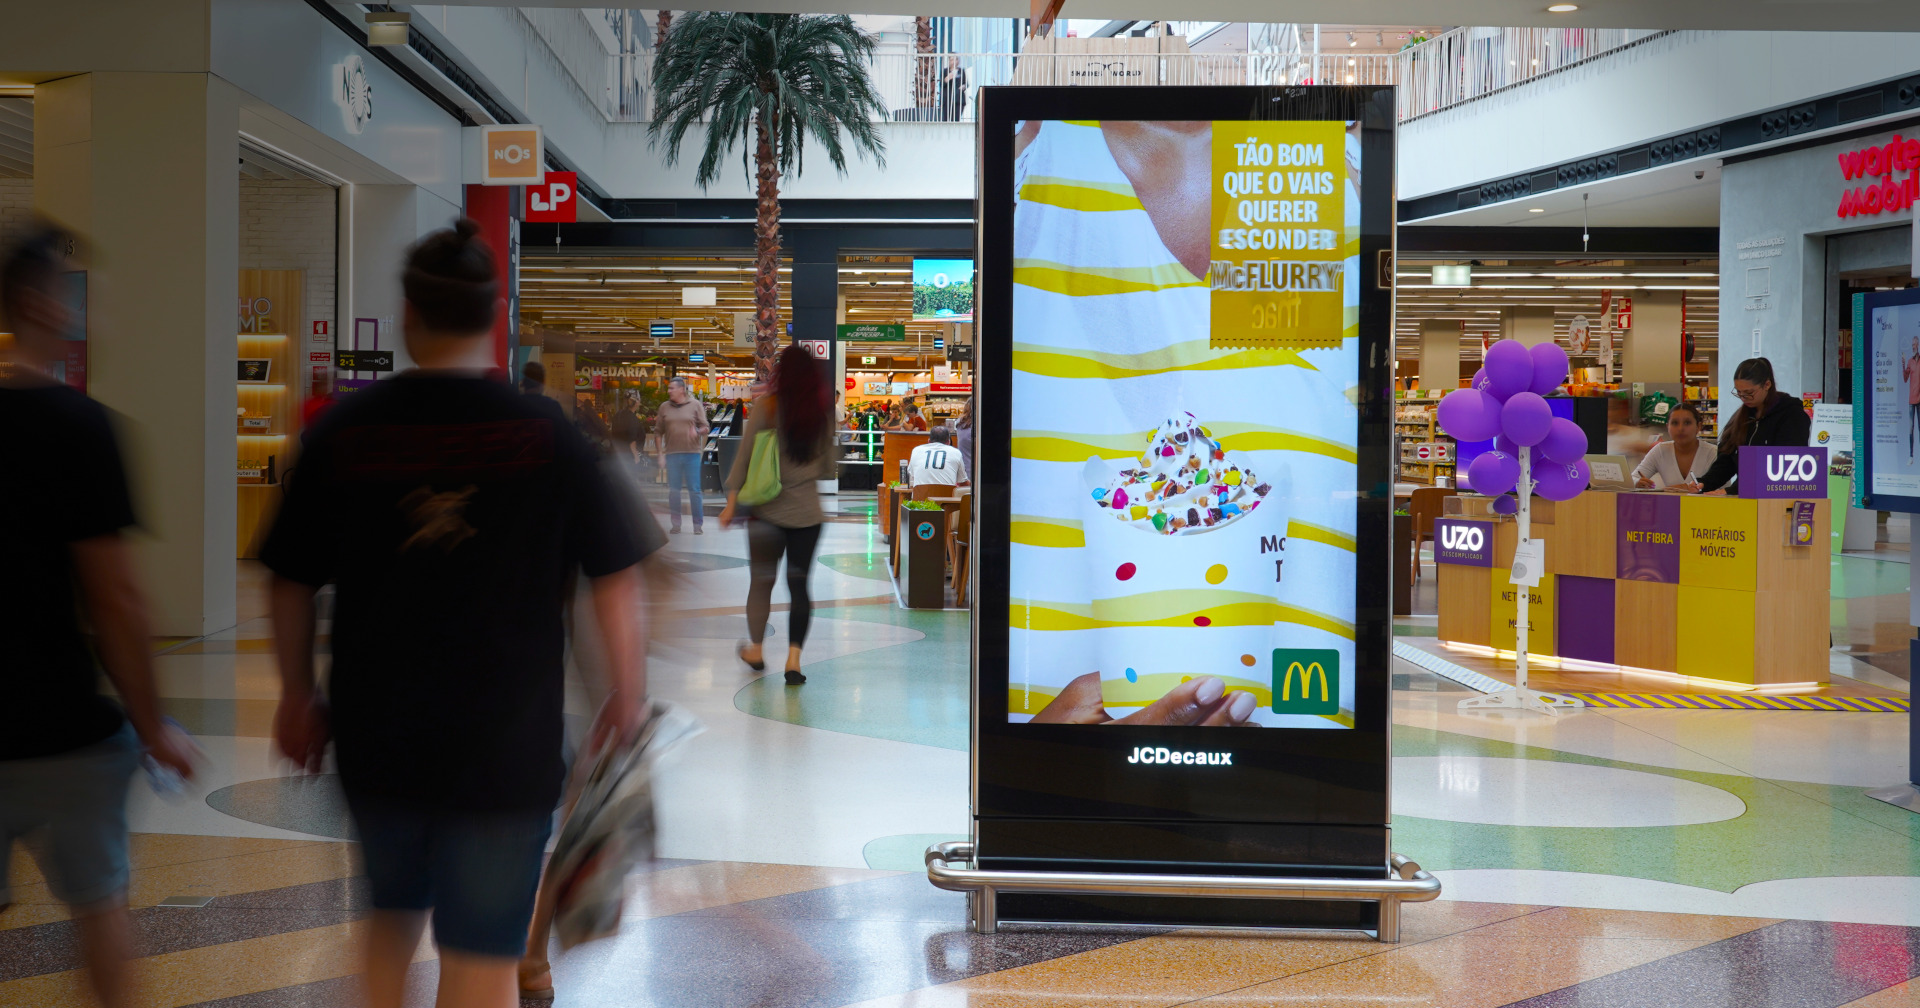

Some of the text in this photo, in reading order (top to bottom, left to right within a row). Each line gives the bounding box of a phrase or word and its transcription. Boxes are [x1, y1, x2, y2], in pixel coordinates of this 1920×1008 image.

[494, 144, 531, 164] NOS
[1234, 137, 1324, 166] TÃO BOM
[1838, 134, 1920, 180] worte
[1223, 171, 1334, 198] QUE O VAIS
[1238, 200, 1318, 226] QUERER
[1218, 228, 1337, 250] ESCONDER
[924, 450, 947, 470] 10
[1766, 454, 1817, 482] UZO
[1766, 484, 1817, 492] DESCOMPLICADO
[1441, 525, 1484, 551] UZO
[1626, 530, 1674, 545] NET FIBRA
[1691, 526, 1745, 542] TARIFÁRIOS
[1442, 551, 1483, 560] DESCOMPLICADO
[1700, 543, 1736, 558] MÓVEIS
[1501, 591, 1518, 602] NET
[1127, 747, 1232, 765] JCDecaux
